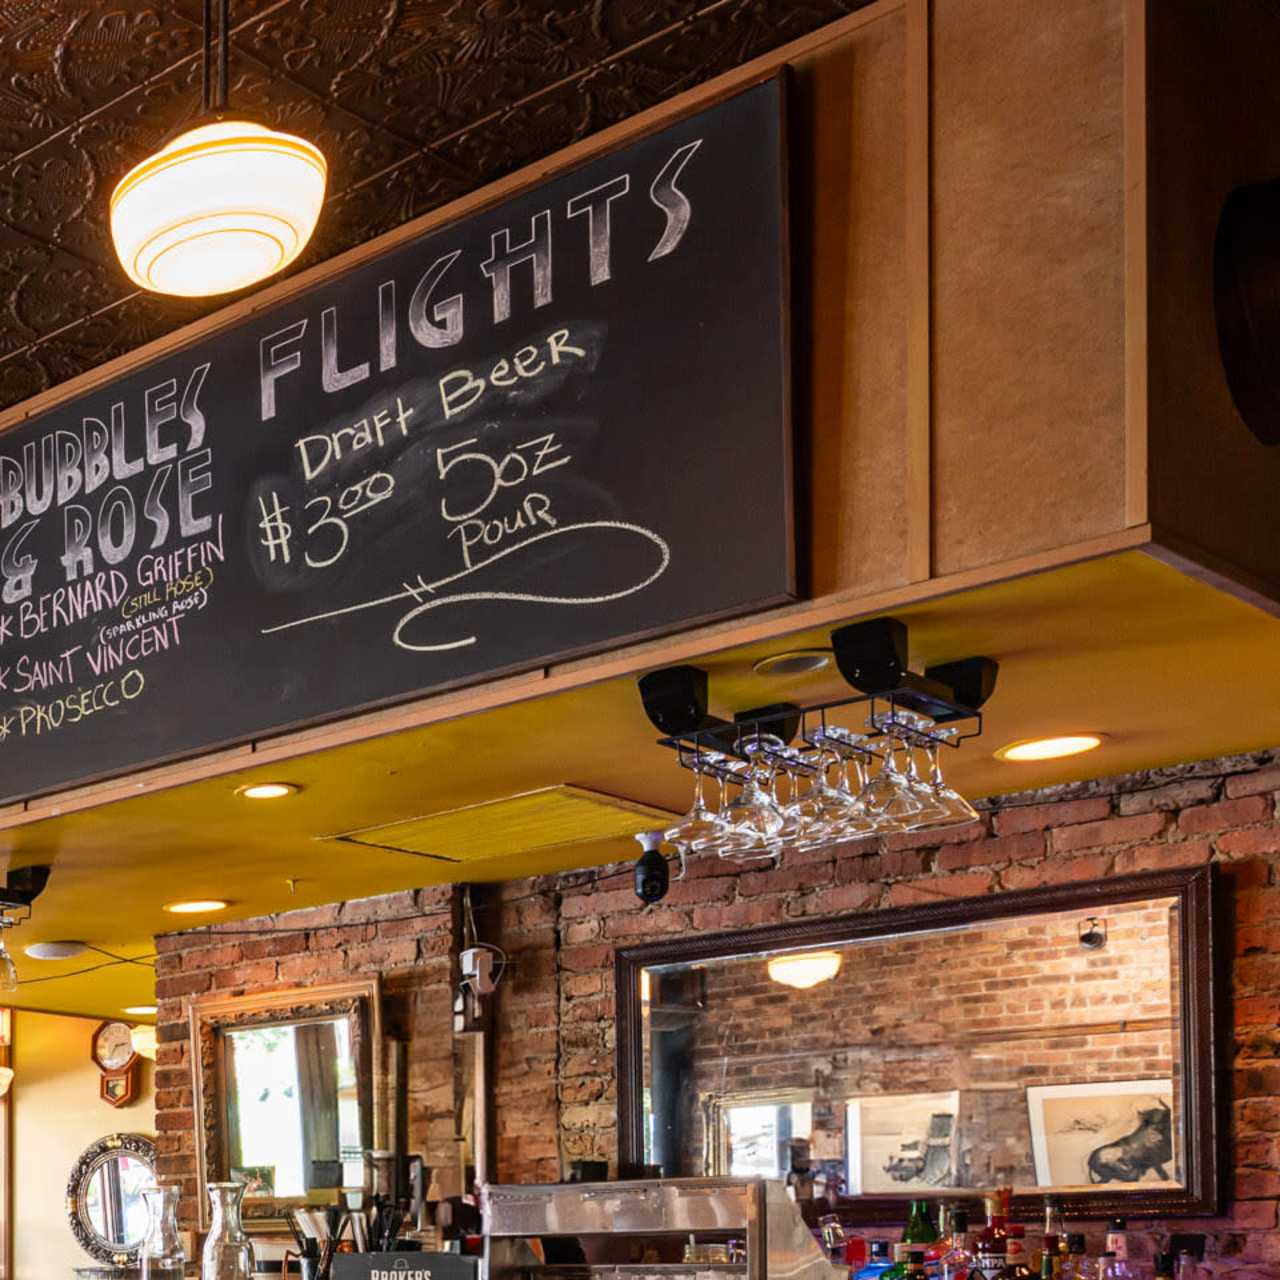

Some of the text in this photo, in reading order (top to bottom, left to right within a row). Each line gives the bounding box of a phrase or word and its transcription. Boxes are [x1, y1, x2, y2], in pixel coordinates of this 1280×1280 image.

[258, 138, 704, 422] FLIGHTS
[19, 513, 225, 640] BERNARD GRIFFIN
[60, 448, 213, 581] ROSE
[13, 613, 186, 693] SAINT VINCENT
